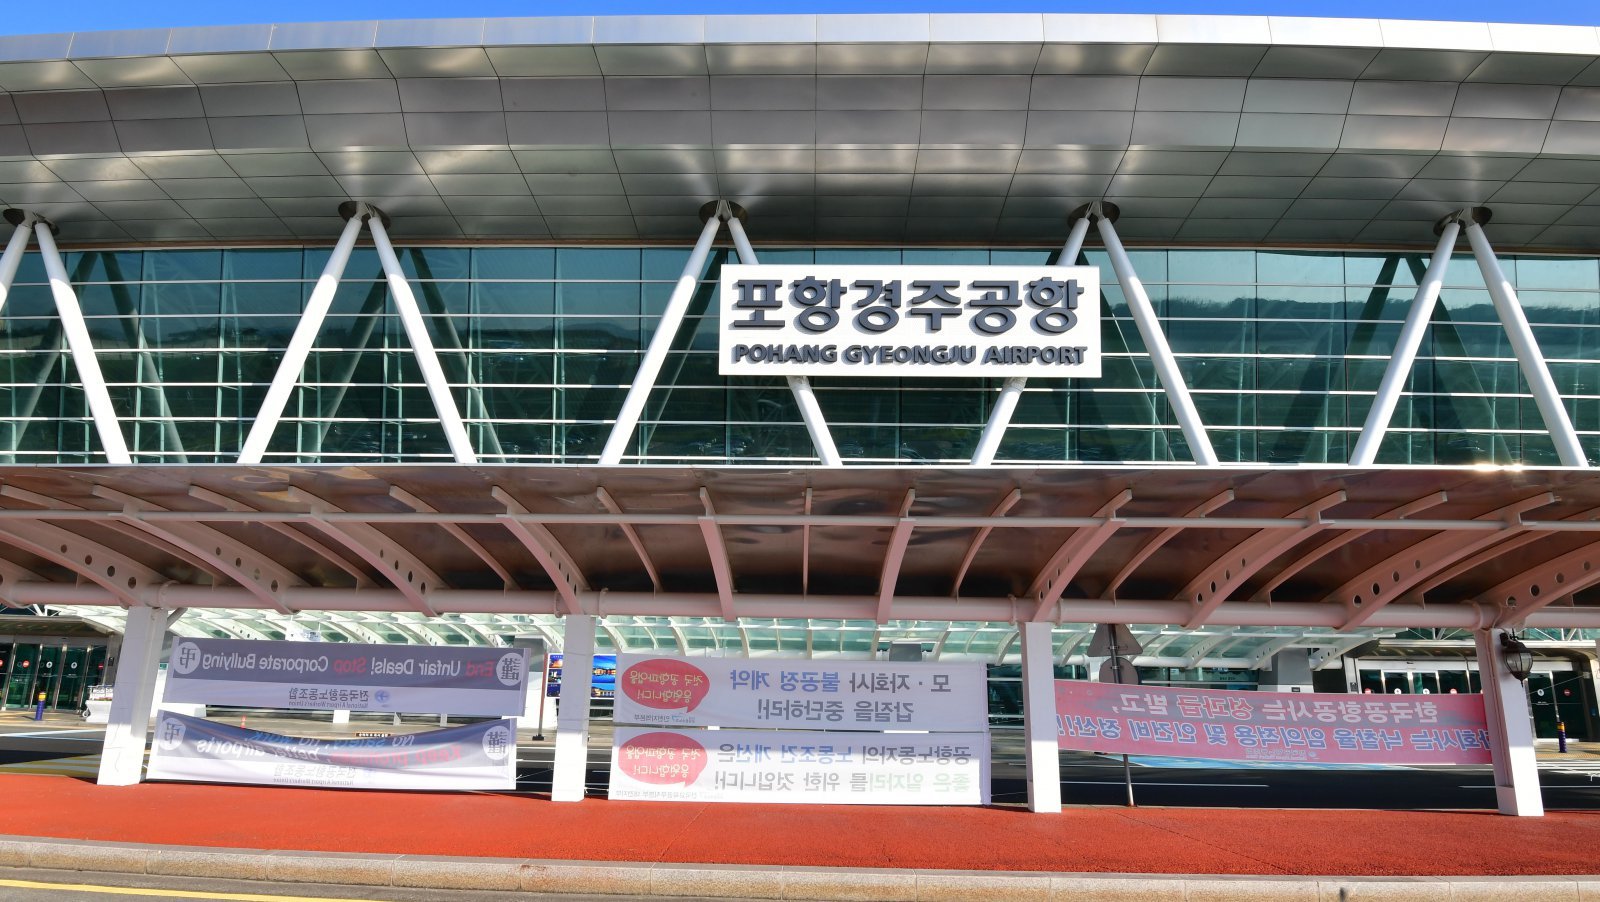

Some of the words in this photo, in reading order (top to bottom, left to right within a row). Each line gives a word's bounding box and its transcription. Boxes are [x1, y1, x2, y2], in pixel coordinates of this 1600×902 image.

[732, 276, 1085, 334] 포항경주공항
[734, 344, 838, 365] POHANG
[845, 344, 977, 366] GYEONGJU
[984, 345, 1088, 366] AIRPORT
